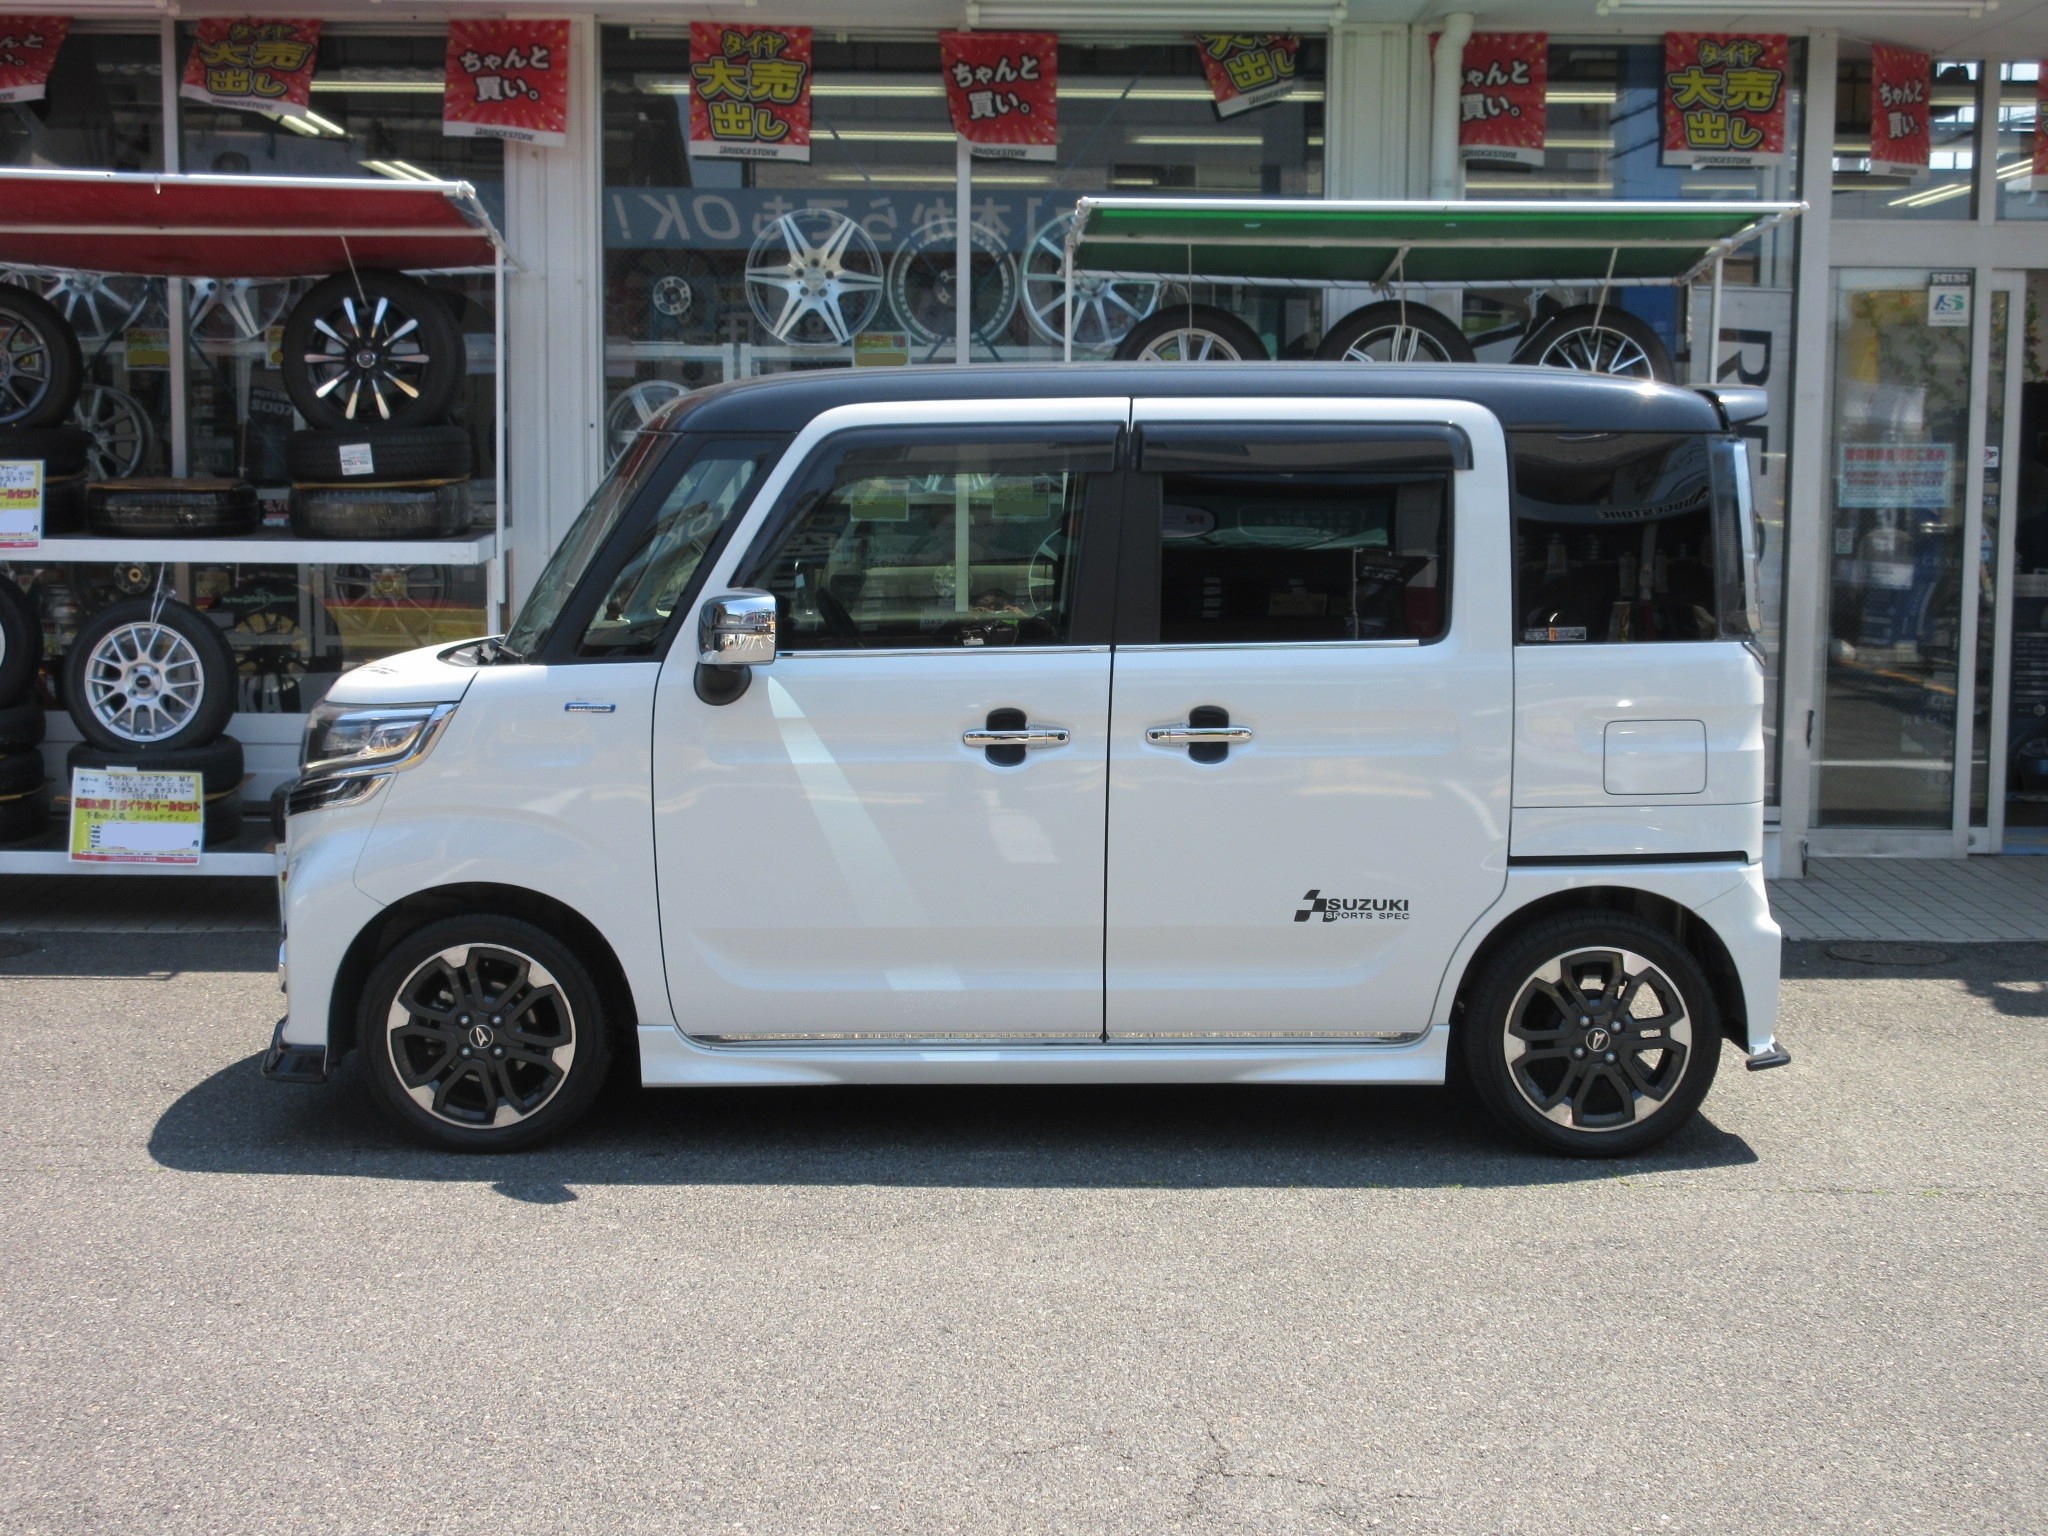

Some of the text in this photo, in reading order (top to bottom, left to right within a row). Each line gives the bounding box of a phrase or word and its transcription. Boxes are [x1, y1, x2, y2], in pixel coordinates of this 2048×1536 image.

[231, 24, 296, 41] タイヤ
[722, 31, 786, 57] タイヤ
[200, 40, 312, 70] 大売
[460, 46, 549, 73] ちゃんと
[1699, 40, 1763, 67] タイヤ
[206, 68, 287, 96] 出し
[692, 57, 806, 103] 大売
[952, 55, 1039, 88] ちゃんと
[1461, 60, 1530, 88] ゃんと
[475, 76, 539, 102] 買い。
[1668, 66, 1782, 111] 大売
[1879, 79, 1923, 107] ちゃんと
[969, 91, 1029, 119] 買い。
[709, 100, 789, 140] 出し
[1684, 109, 1762, 149] 出し
[475, 127, 534, 141] BRIDGESTONE
[719, 146, 778, 156] BRIDGESTONE
[972, 146, 1028, 157] BRIDGESTONE
[1325, 911, 1410, 920] SPORTS SPEC
[1327, 898, 1409, 912] SUZUKI
